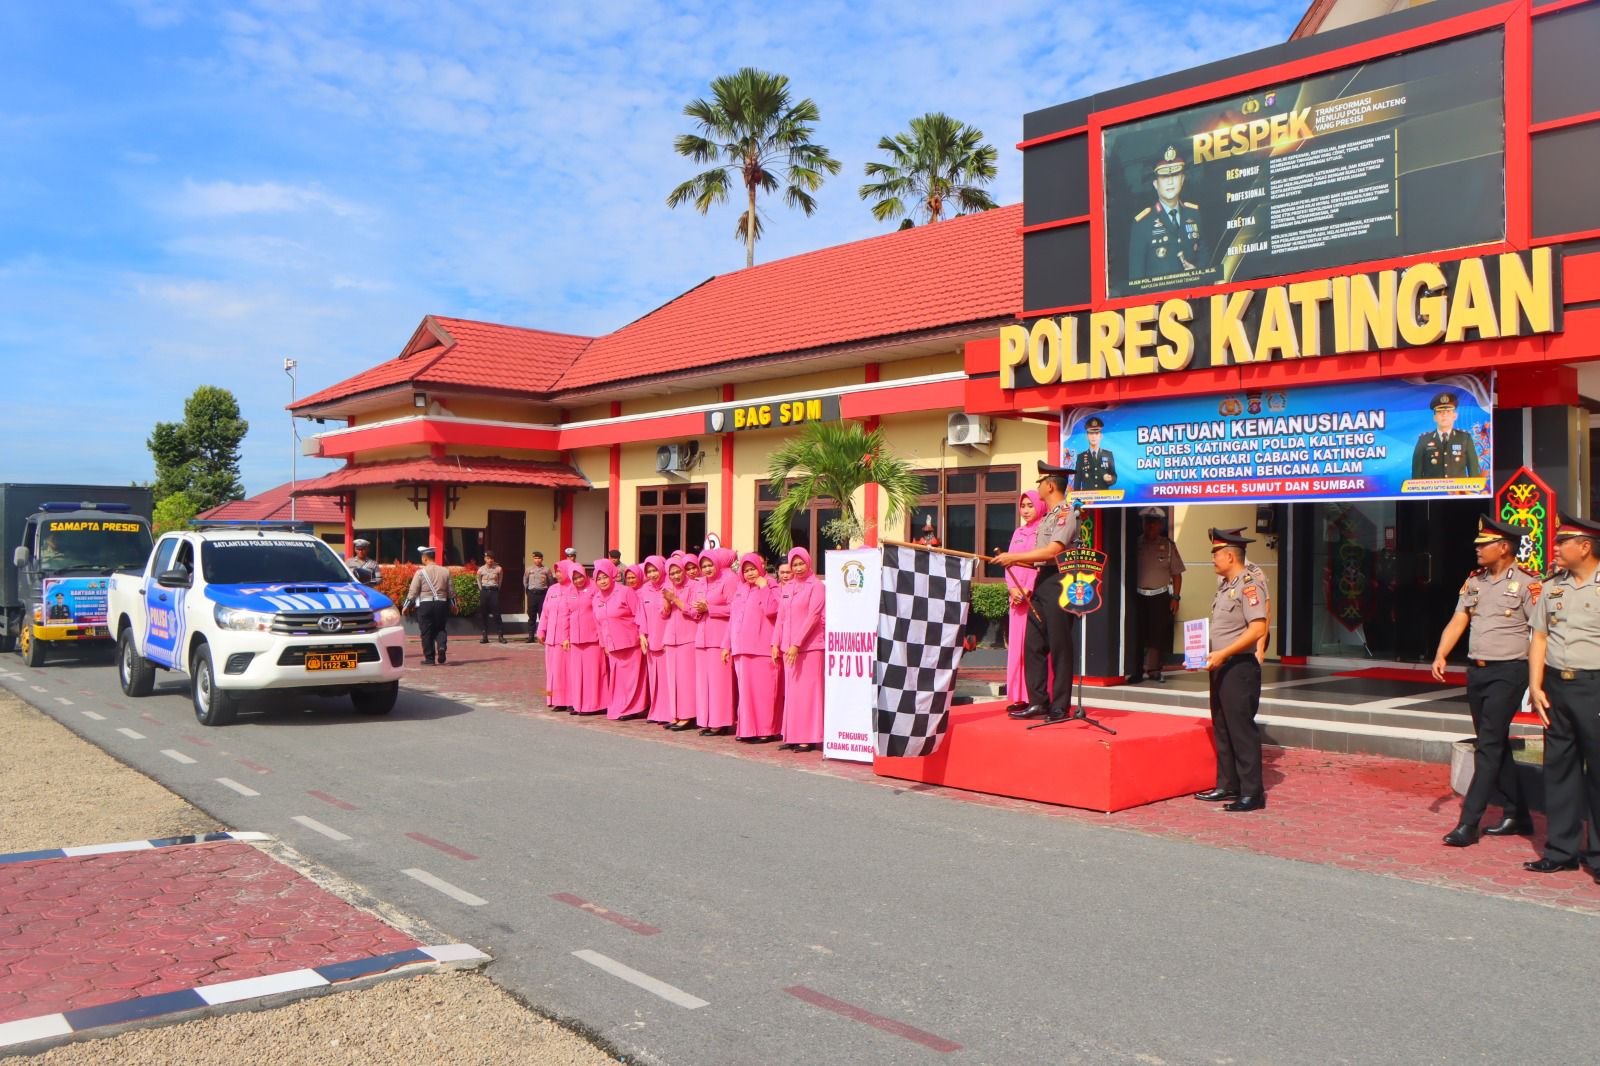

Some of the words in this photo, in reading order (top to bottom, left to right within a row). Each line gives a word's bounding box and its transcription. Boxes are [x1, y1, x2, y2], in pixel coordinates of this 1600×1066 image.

[1315, 97, 1371, 116] TRANSFORMASI
[1315, 112, 1346, 125] MENUJU
[1346, 106, 1372, 118] POLDA
[1372, 96, 1406, 112] KALTENG
[1315, 121, 1336, 132] YANG
[1336, 115, 1363, 128] PRESISI
[1192, 107, 1313, 164] RESPEK
[1227, 188, 1265, 203] PROFESIONAL
[1000, 298, 1194, 388] POLRES
[1210, 247, 1555, 366] KATINGAN
[734, 405, 771, 428] BAG
[779, 399, 822, 423] SDM
[1137, 421, 1225, 443] BANTUAN
[1231, 410, 1384, 437] KEMANUSIAAN
[1146, 444, 1191, 456] POLRES
[1195, 440, 1258, 453] KATINGAN
[1263, 438, 1305, 449] POLDA
[1309, 433, 1375, 447] KALTENG
[1137, 458, 1160, 469] DAN
[1164, 454, 1250, 468] BHAYANGKARI
[1255, 451, 1309, 463] CABANG
[1313, 446, 1386, 460] KATINGAN
[1156, 469, 1197, 480] UNTUK
[1201, 466, 1252, 479] KORBAN
[1257, 464, 1319, 476] BENCANA
[1323, 462, 1362, 474] ALAM
[1153, 485, 1202, 495] PROVINSI
[1205, 484, 1238, 494] ACEH,
[1241, 482, 1281, 493] SUMUT
[1285, 481, 1309, 491] DAN
[1313, 479, 1365, 490] SUMBAR
[50, 522, 99, 531] SAMAPTA
[102, 522, 140, 532] PRESISI
[828, 654, 874, 678] PEDUL
[838, 731, 869, 741] PENGURUS
[826, 742, 849, 751] CABANG
[850, 743, 874, 753] KATINGA
